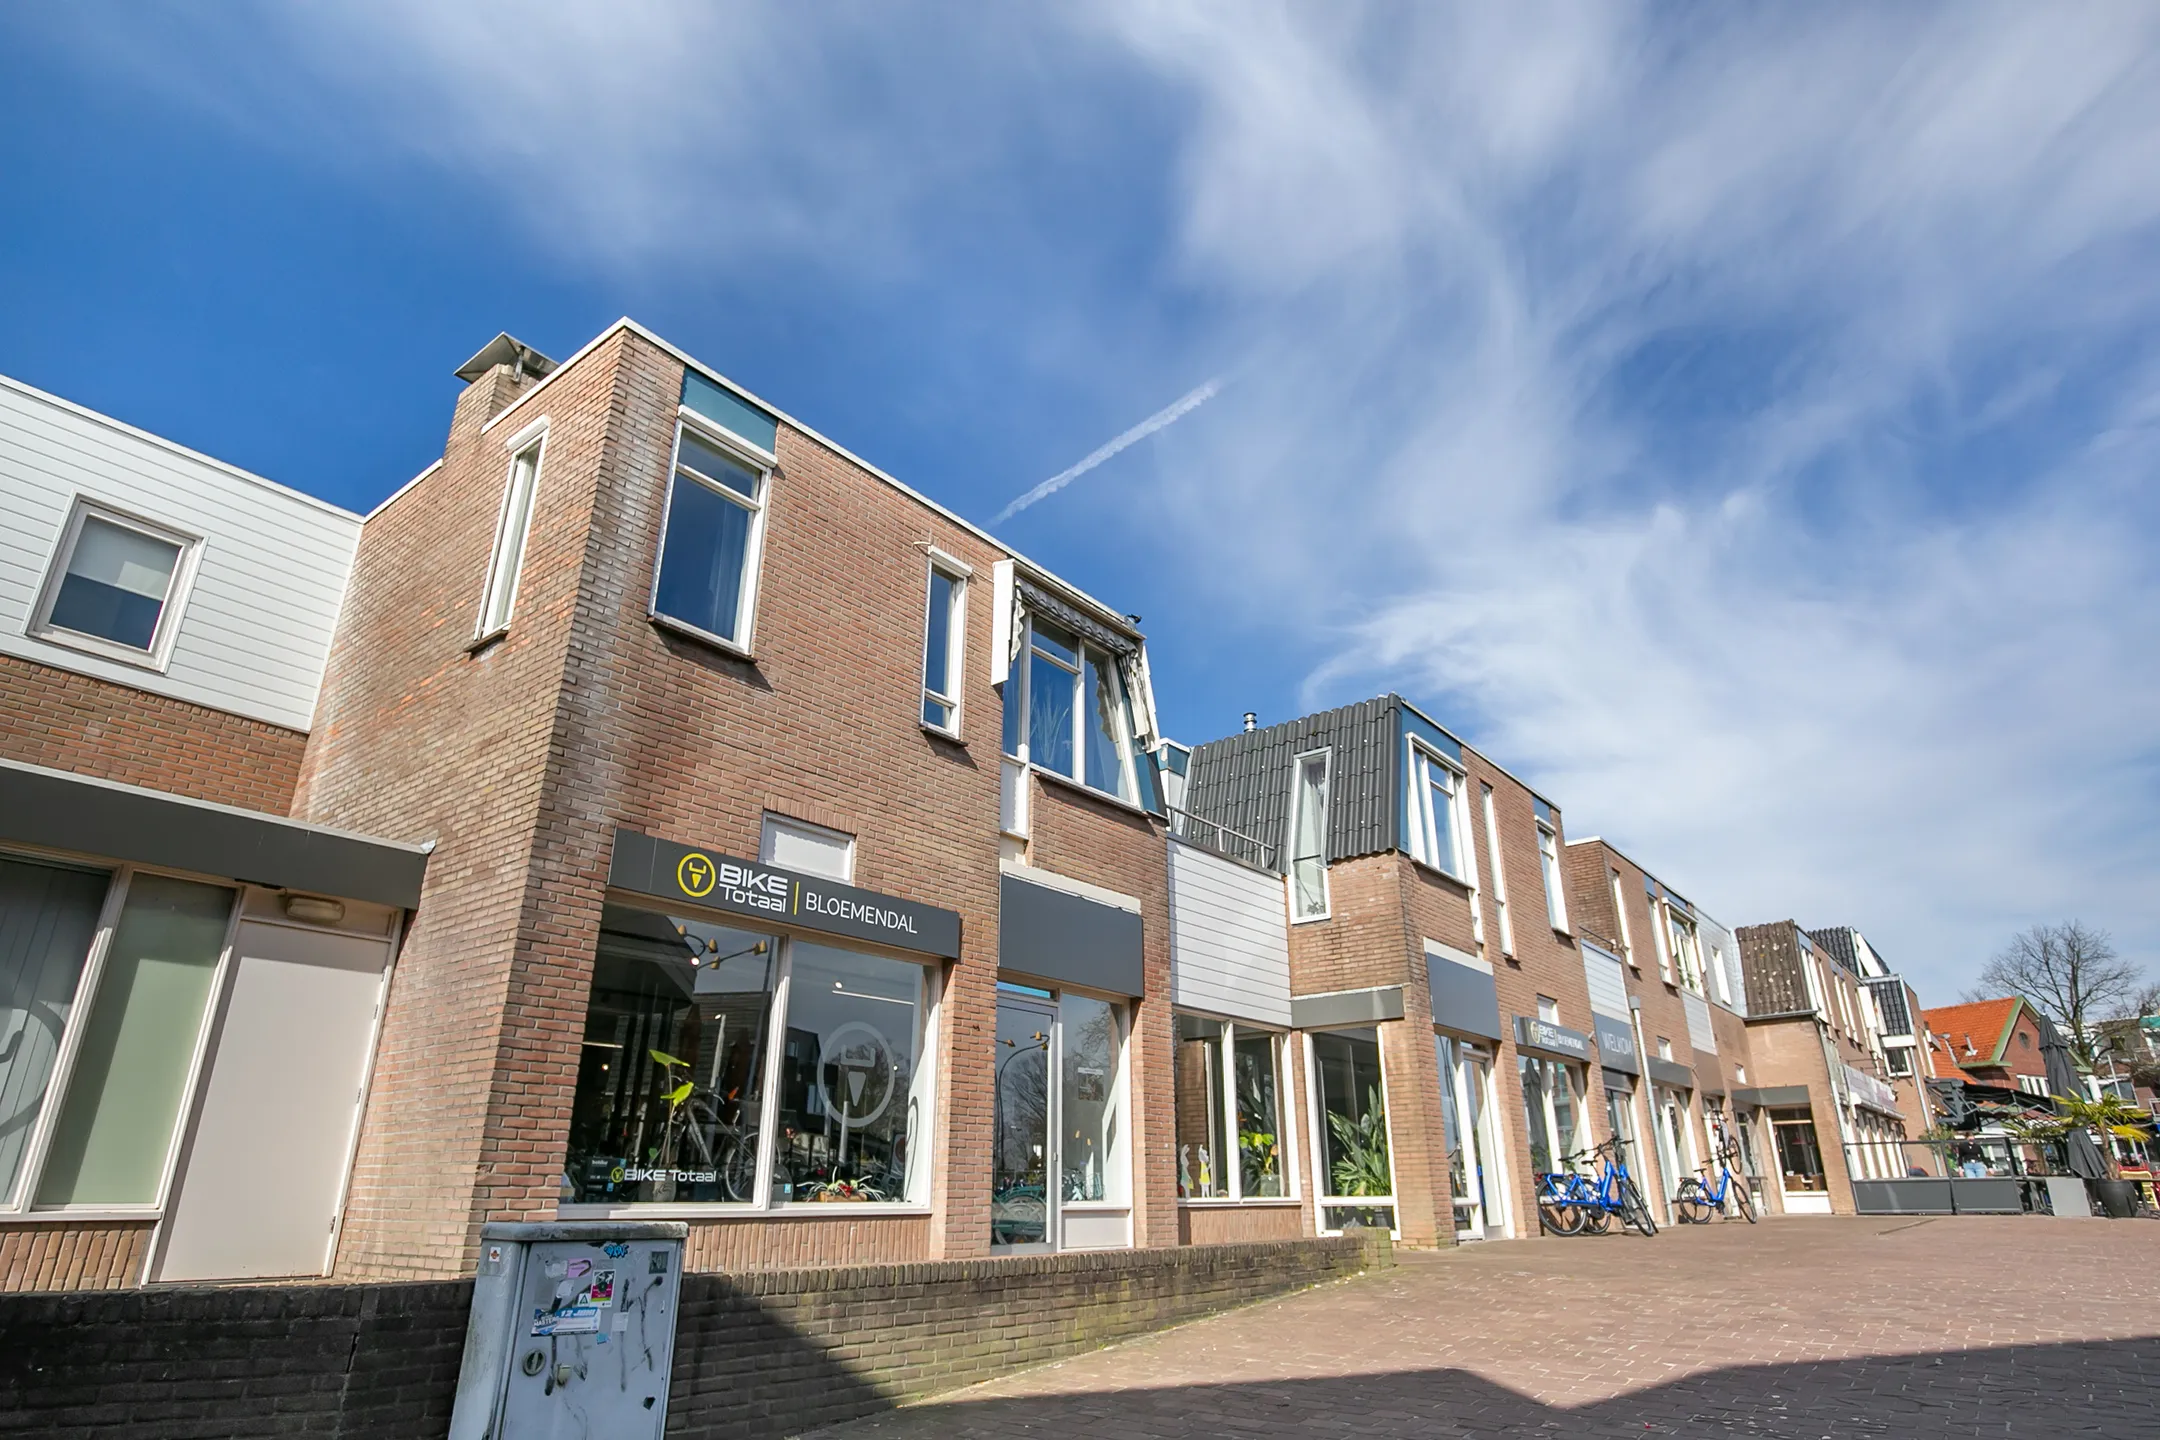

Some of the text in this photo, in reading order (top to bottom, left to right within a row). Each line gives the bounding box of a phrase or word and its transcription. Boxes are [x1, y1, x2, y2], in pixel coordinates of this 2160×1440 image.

[719, 863, 788, 896] BIKE
[719, 884, 786, 913] Totaal
[805, 892, 918, 934] BLOEMENDAL
[1601, 1031, 1634, 1056] WELKOM
[624, 1168, 717, 1182] BIKE Totaal
